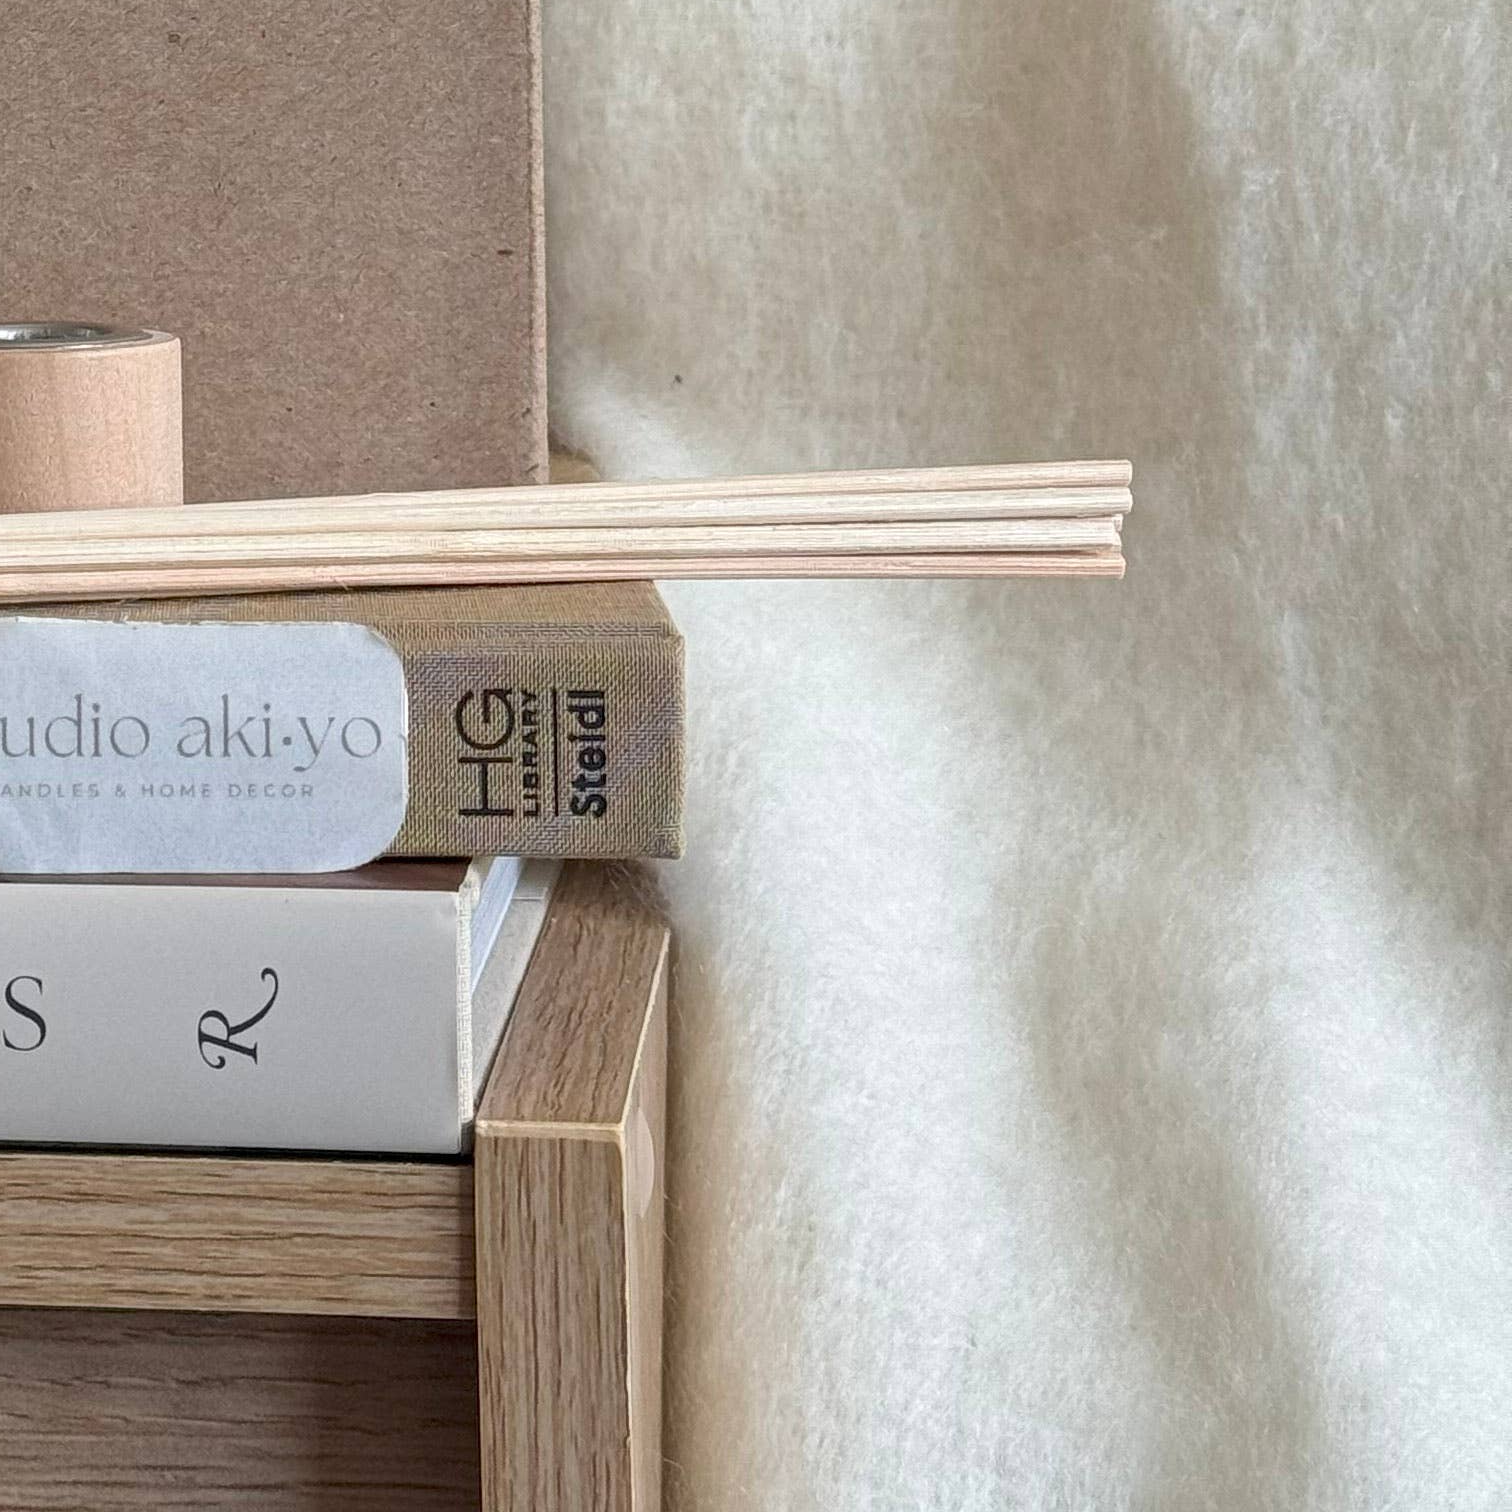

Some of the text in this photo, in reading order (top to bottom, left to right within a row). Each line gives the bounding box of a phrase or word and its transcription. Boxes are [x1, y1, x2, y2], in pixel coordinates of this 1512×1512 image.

[115, 784, 125, 797] &
[141, 784, 210, 798] HOME
[228, 784, 313, 798] DECOR
[456, 688, 514, 816] HG
[522, 690, 538, 816] LIBRARY
[567, 690, 607, 818] Steidl
